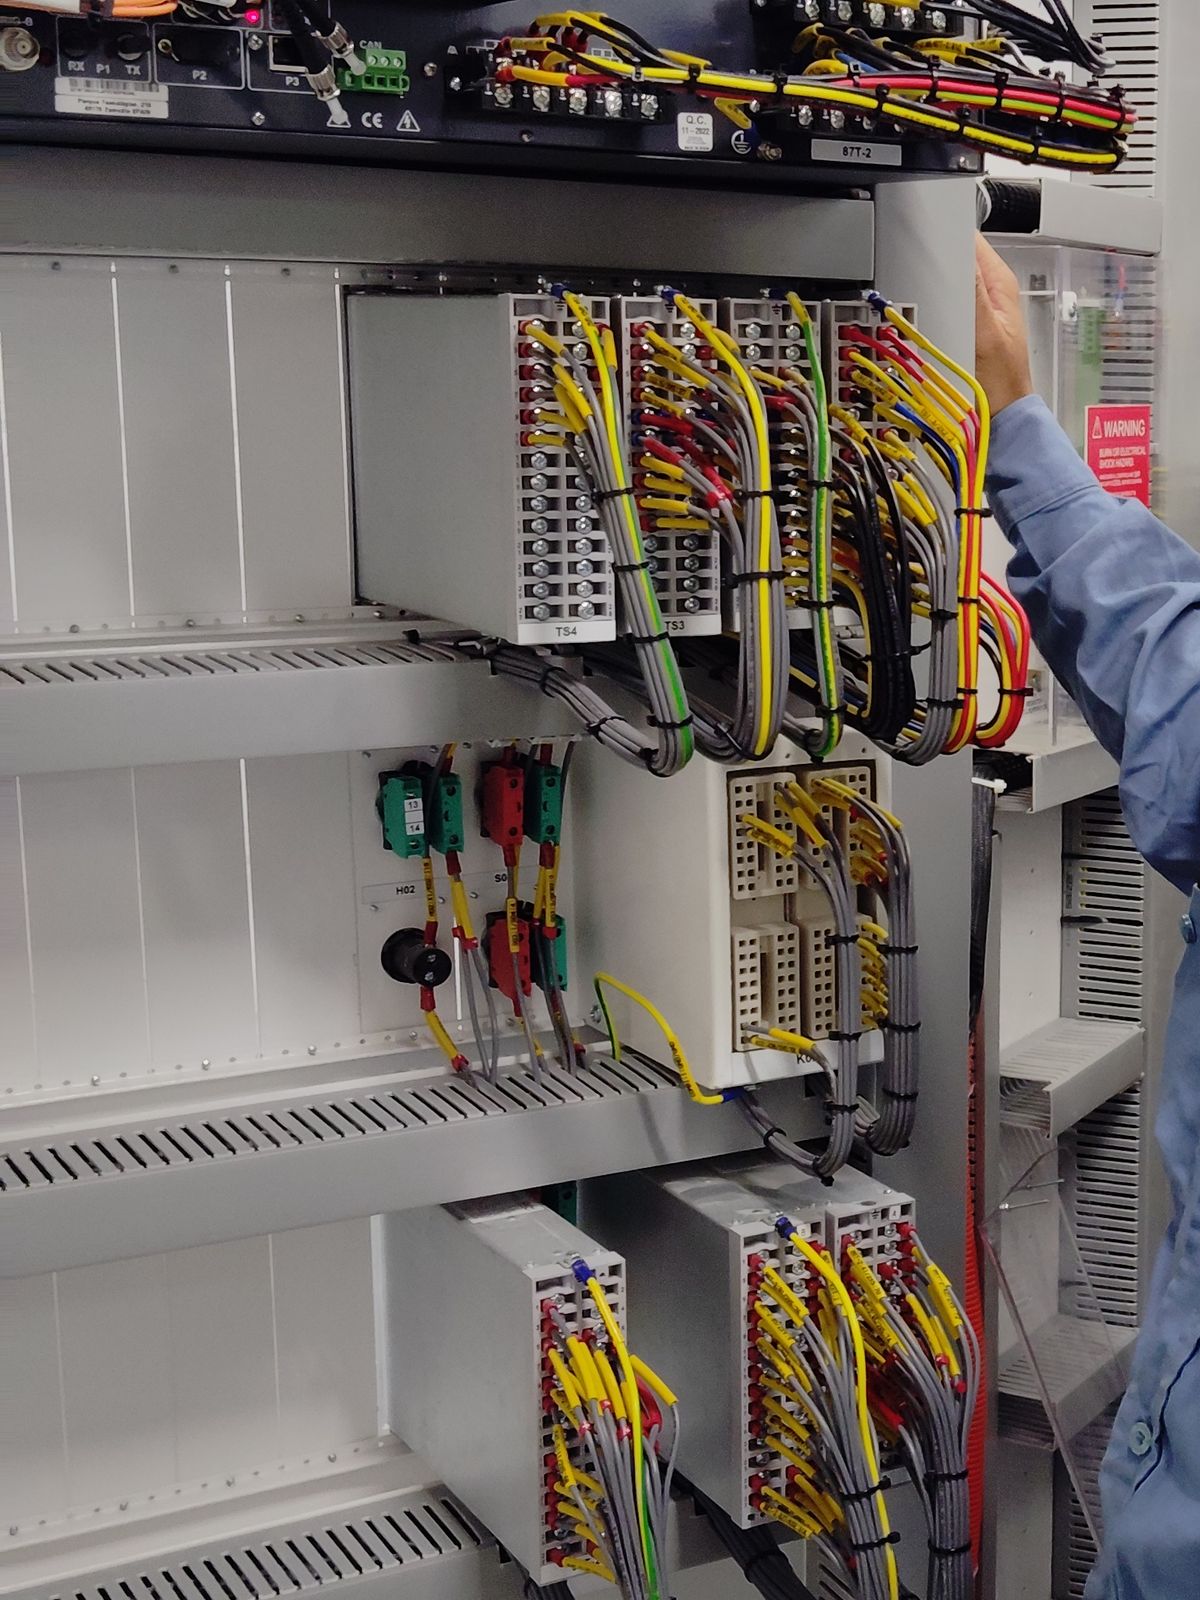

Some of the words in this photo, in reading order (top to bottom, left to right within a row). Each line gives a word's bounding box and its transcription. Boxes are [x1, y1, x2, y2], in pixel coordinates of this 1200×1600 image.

[68, 60, 86, 72] RX
[96, 63, 110, 74] P1
[125, 64, 141, 76] TX
[192, 70, 208, 81] P2
[285, 76, 300, 87] P3
[842, 146, 872, 158] 87T-2
[1104, 419, 1145, 437] WARNING
[665, 620, 685, 631] TS3
[555, 626, 578, 637] TS4
[408, 800, 418, 809] 13
[410, 824, 420, 833] 14
[494, 873, 508, 883] S0
[395, 885, 416, 896] H02
